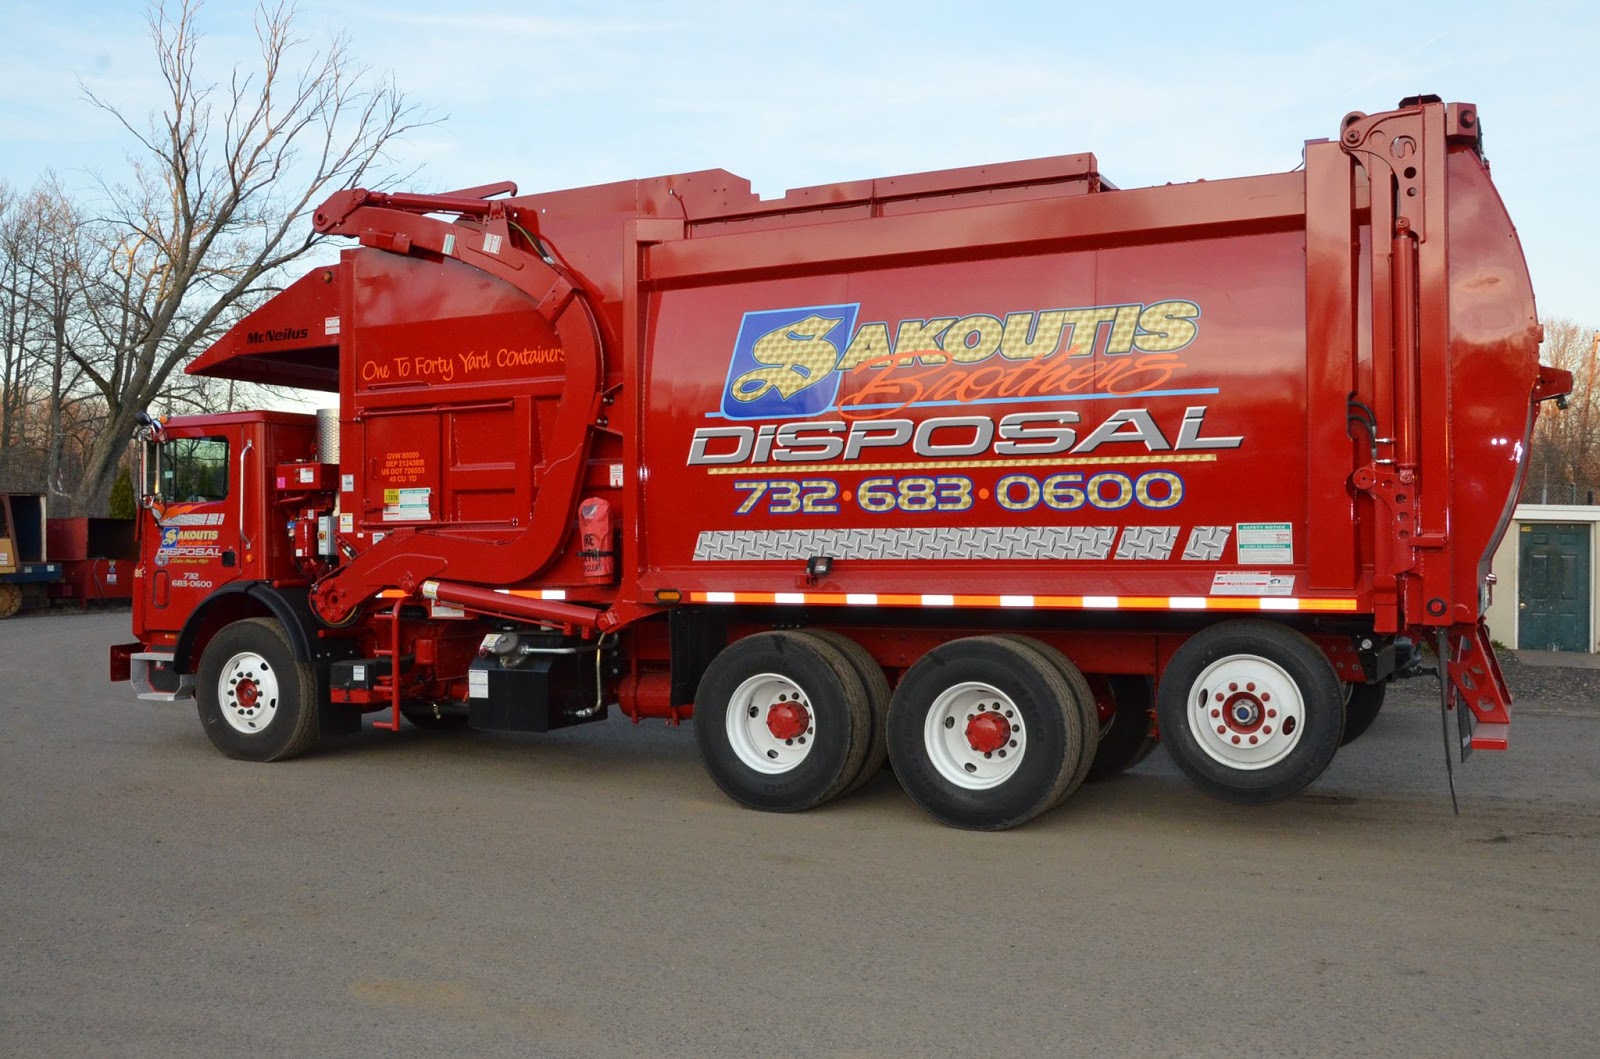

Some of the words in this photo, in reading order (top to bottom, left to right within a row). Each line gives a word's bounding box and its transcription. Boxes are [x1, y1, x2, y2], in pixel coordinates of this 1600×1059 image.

[247, 328, 309, 345] McNeilus
[730, 299, 1200, 402] SAKOUTIS
[362, 360, 390, 380] One
[394, 357, 411, 377] To
[415, 356, 454, 381] Forty
[458, 351, 491, 374] Yard
[837, 344, 1188, 420] Brothers
[687, 406, 1245, 466] DISPOSAL
[390, 467, 403, 475] DOT
[162, 529, 219, 545] SAKOUTIS
[157, 548, 223, 557] DISPOSAL
[183, 572, 199, 580] 732
